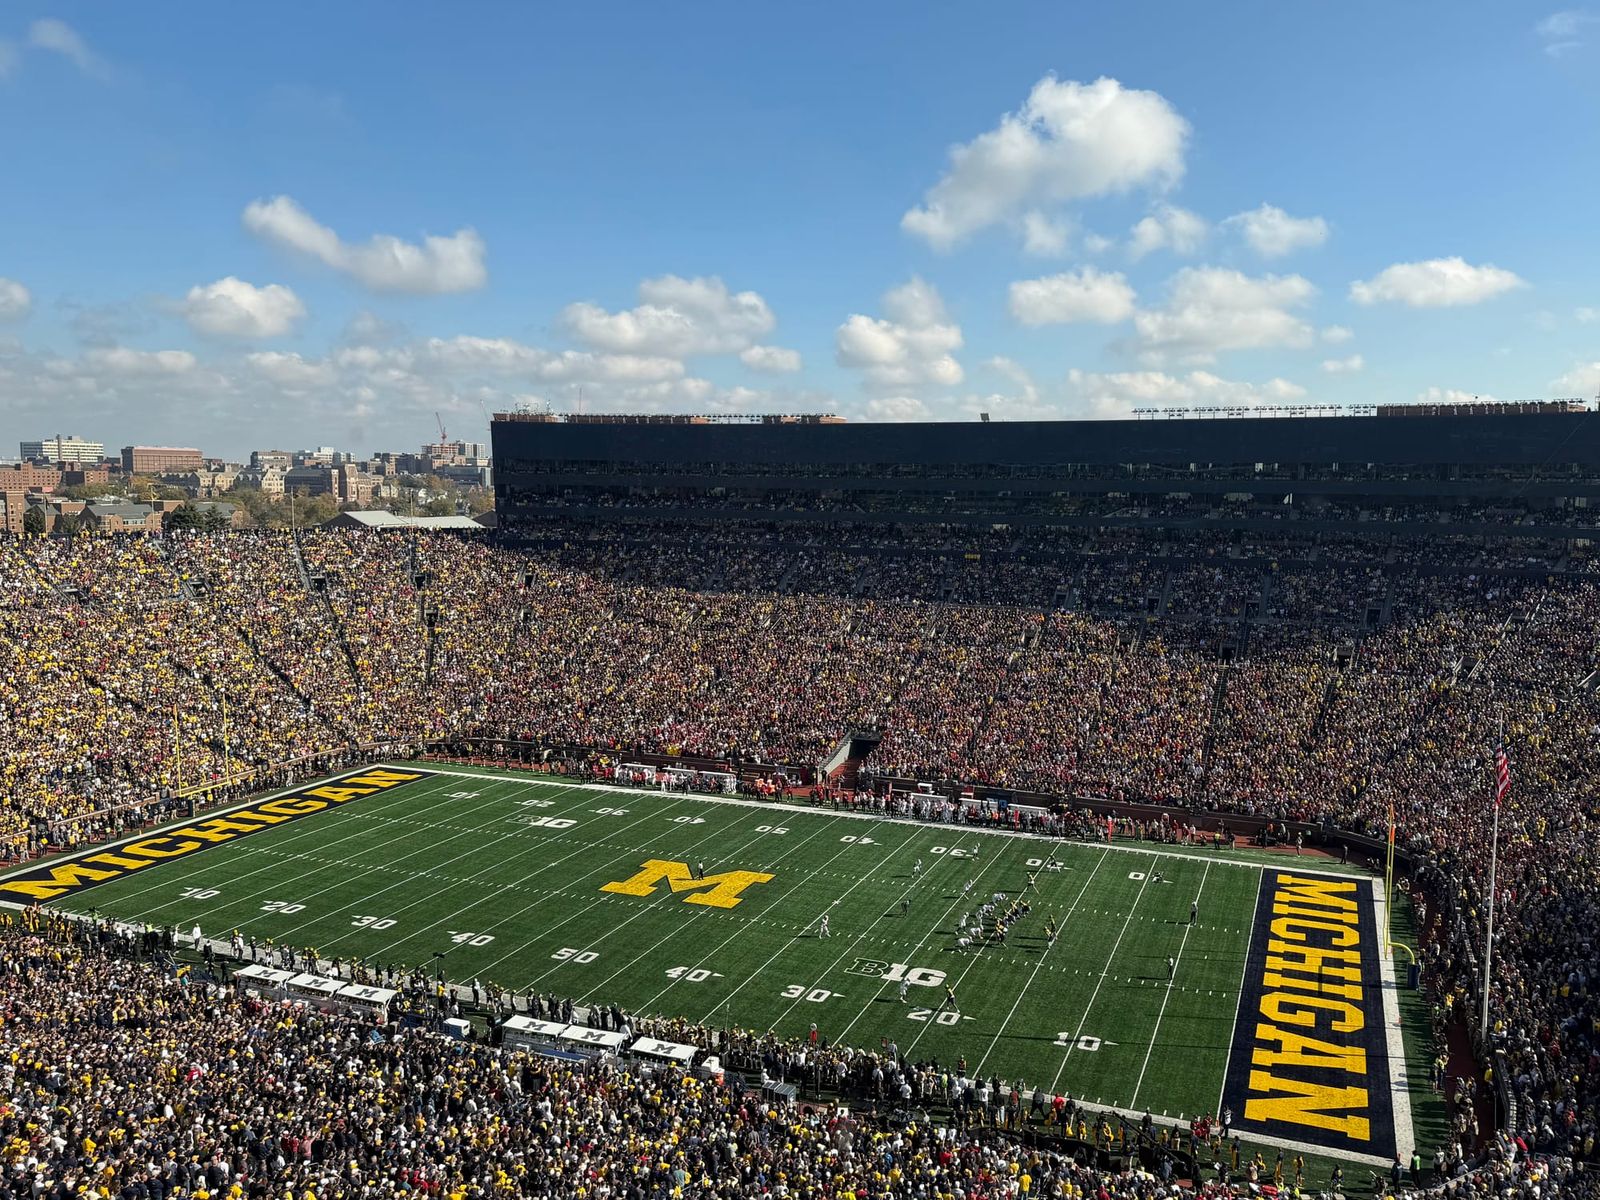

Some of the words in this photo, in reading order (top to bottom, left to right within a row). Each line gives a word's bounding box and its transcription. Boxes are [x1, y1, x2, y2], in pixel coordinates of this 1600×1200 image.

[0, 770, 423, 899] MICHIGAN
[754, 825, 790, 835] 50
[840, 835, 875, 845] 40
[930, 846, 967, 857] 30
[598, 859, 776, 909] M
[179, 887, 221, 900] 10
[259, 900, 307, 914] 20
[351, 915, 398, 930] 30
[450, 931, 495, 946] 40
[551, 947, 600, 963] 50
[254, 969, 278, 978] M
[665, 966, 711, 982] 40
[305, 978, 329, 988] M
[355, 988, 379, 998] M
[781, 984, 832, 1003] 30
[1244, 874, 1370, 1141] MICHIGAN
[907, 1006, 961, 1026] 20
[523, 1021, 547, 1031] M
[581, 1031, 606, 1042] M
[1053, 1031, 1102, 1052] 10
[652, 1043, 677, 1055] M
